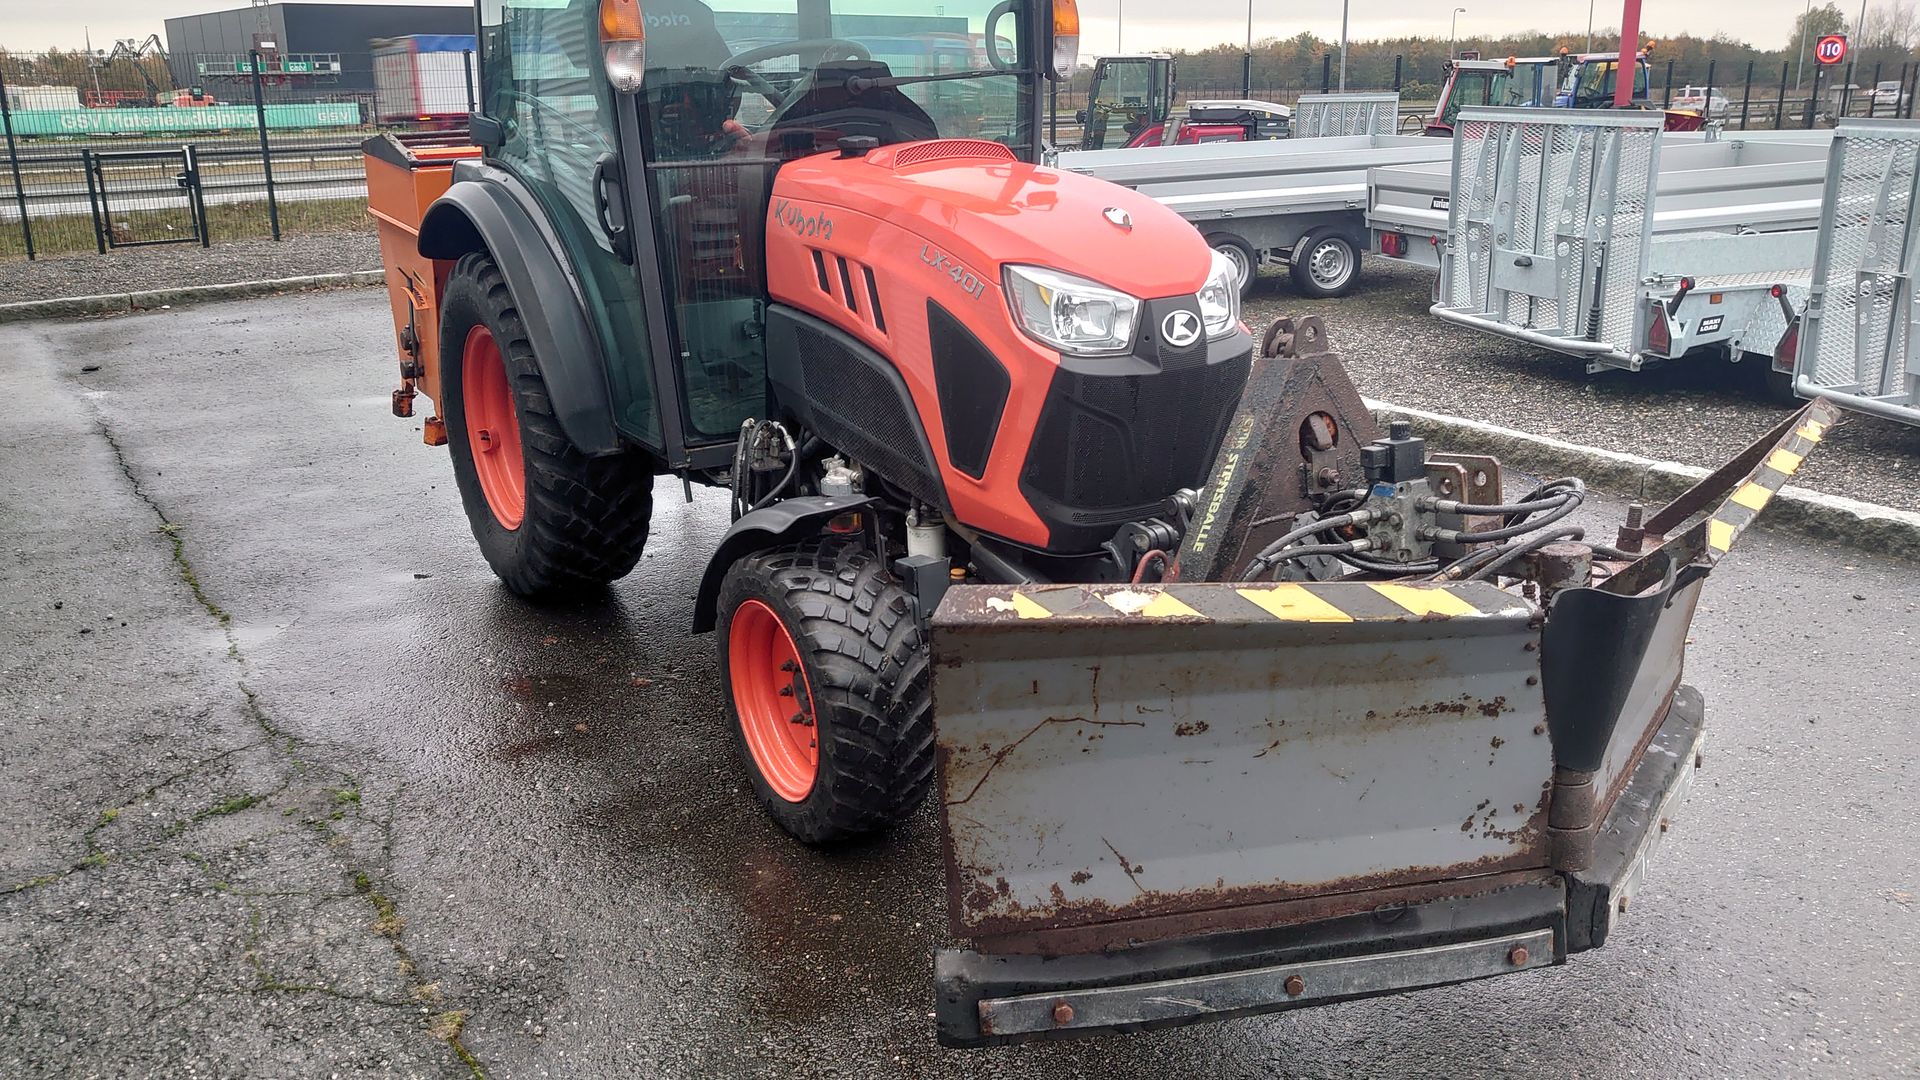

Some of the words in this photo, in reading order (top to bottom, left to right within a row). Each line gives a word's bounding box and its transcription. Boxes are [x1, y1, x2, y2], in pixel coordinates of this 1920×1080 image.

[643, 10, 691, 28] bota
[1820, 43, 1841, 56] 110
[60, 113, 101, 130] GSV
[107, 109, 259, 129] Materieludlejning
[317, 111, 348, 122] GSV
[774, 199, 834, 241] Kubota
[919, 244, 985, 300] LX-401
[1700, 324, 1719, 332] LOAD
[1702, 318, 1721, 326] MAXI
[1192, 451, 1240, 553] STENSBALLE
